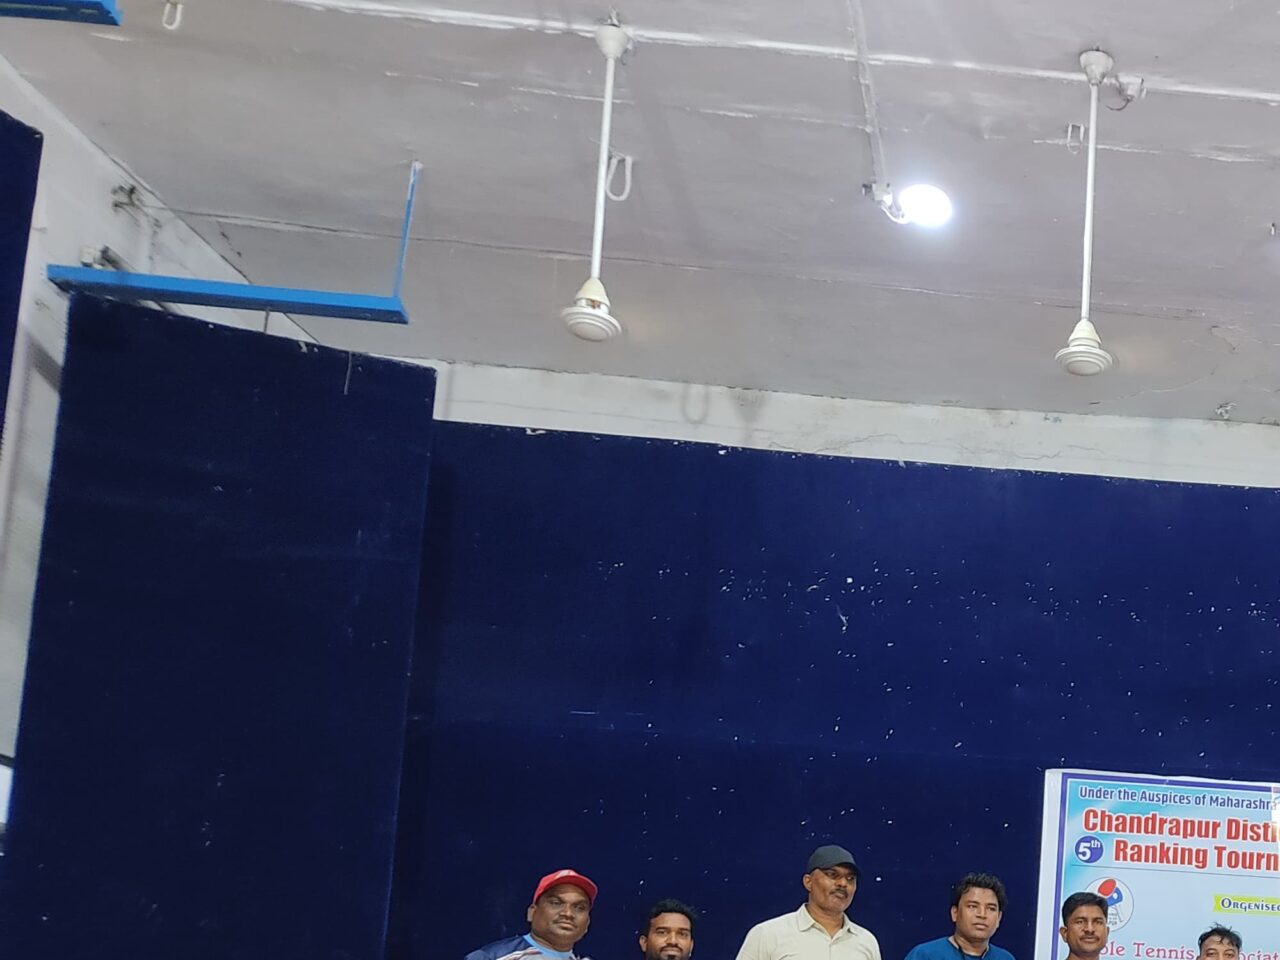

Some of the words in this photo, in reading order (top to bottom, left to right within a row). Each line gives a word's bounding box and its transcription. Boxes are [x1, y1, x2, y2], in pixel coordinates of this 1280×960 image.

[1080, 786, 1114, 799] Under
[1118, 789, 1137, 801] the
[1140, 790, 1191, 805] Auspices
[1195, 794, 1208, 806] of
[1083, 809, 1221, 839] Chandrapur
[1078, 839, 1101, 861] 5th
[1114, 839, 1208, 869] Ranking
[1133, 942, 1195, 960] Tennis
